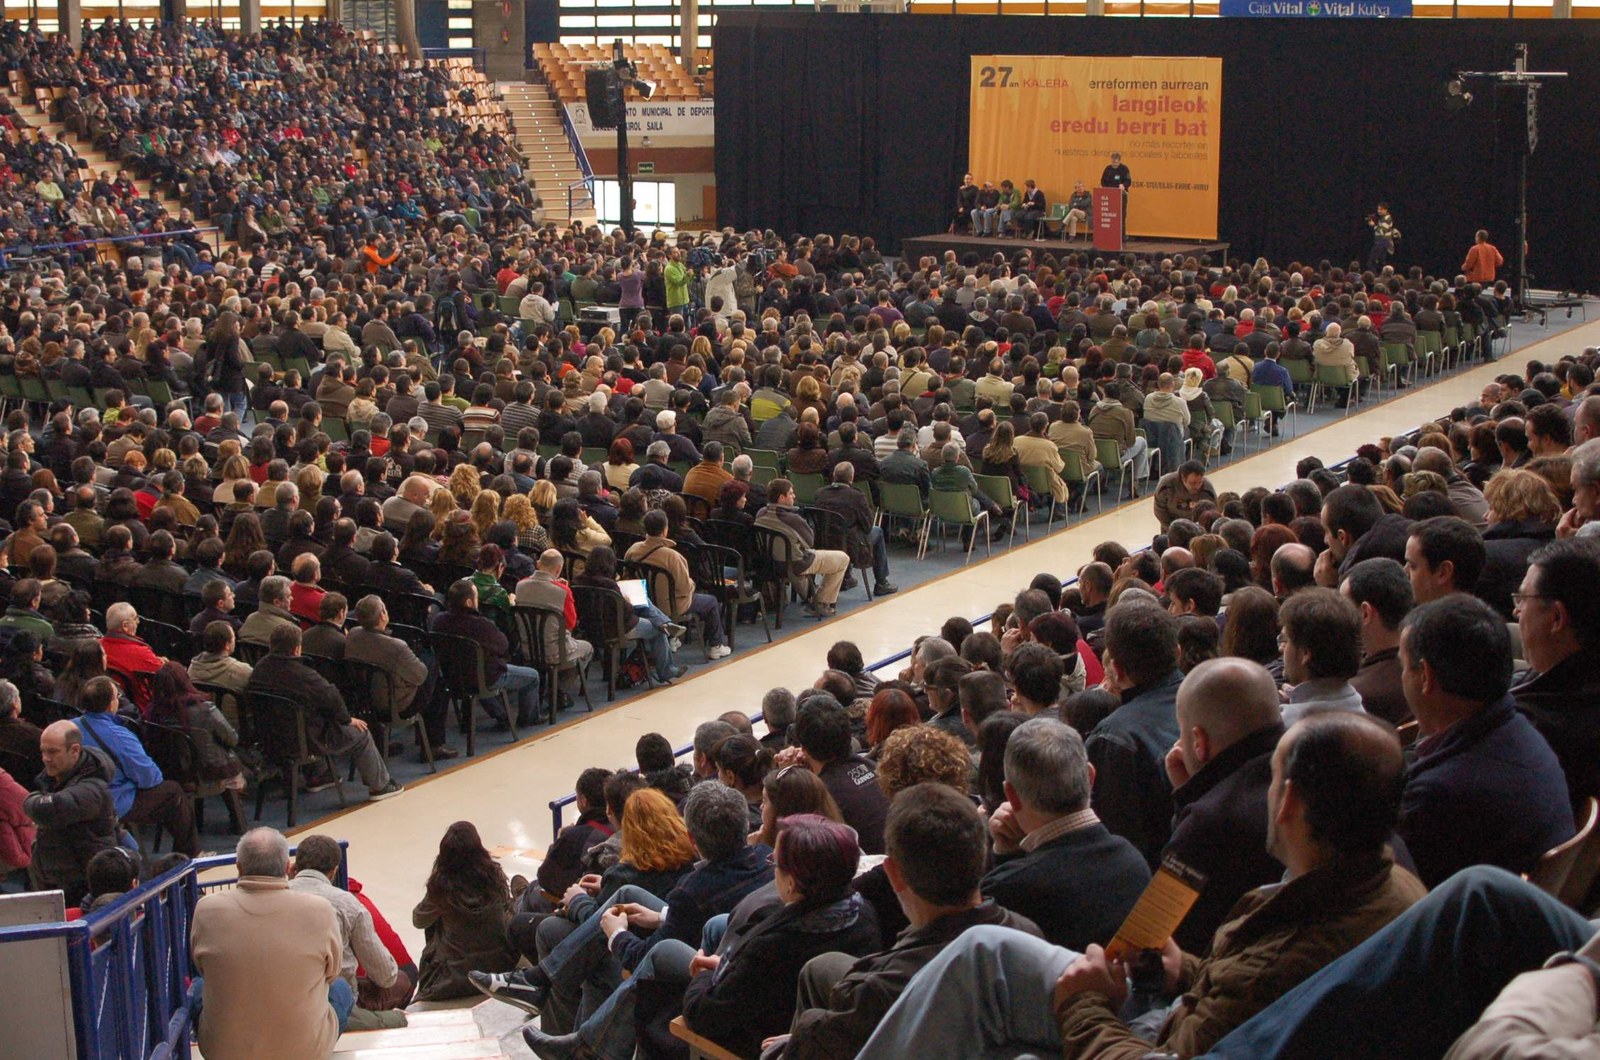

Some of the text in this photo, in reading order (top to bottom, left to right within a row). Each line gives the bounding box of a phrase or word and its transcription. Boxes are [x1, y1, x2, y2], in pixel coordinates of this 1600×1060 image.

[1249, 1, 1390, 16] Caja Vital Vital Kutxa
[1023, 79, 1069, 88] KALERA
[1089, 79, 1209, 90] erreformen aurrean
[1112, 94, 1208, 116] langileok
[642, 107, 672, 116] MUNICIPAL
[678, 107, 685, 116] DE
[646, 121, 663, 131] SAILA
[1050, 117, 1208, 136] eredu berri bat
